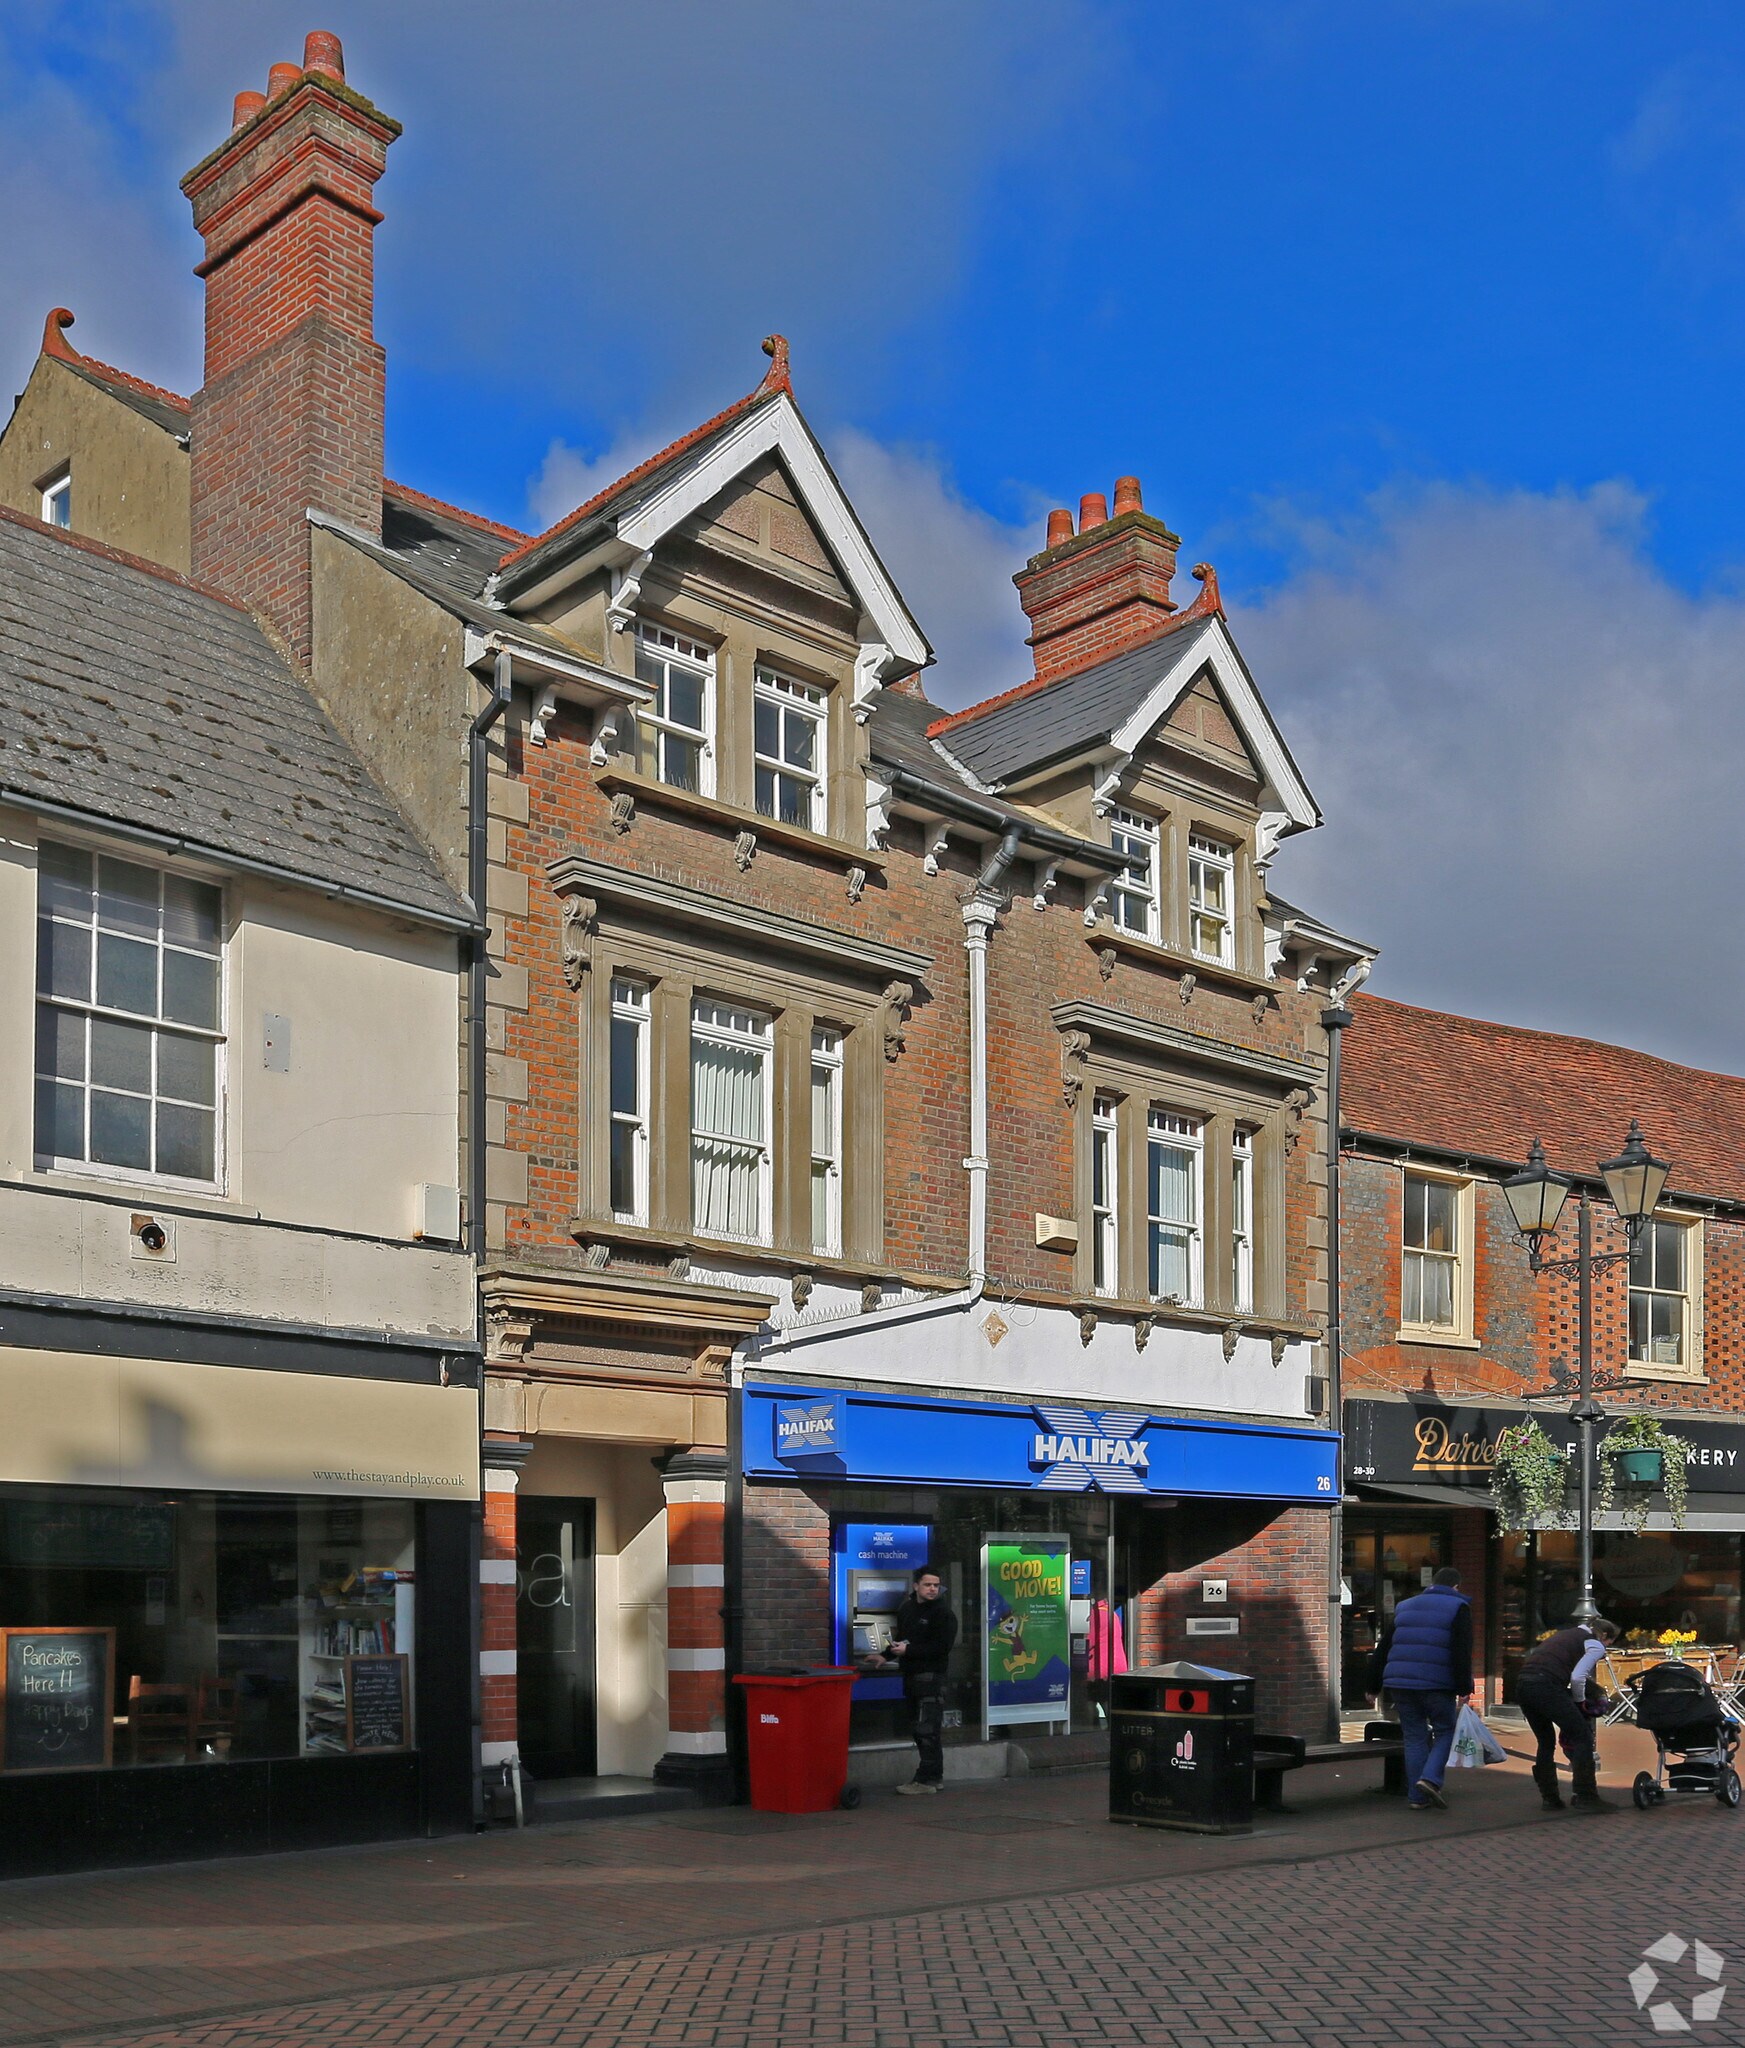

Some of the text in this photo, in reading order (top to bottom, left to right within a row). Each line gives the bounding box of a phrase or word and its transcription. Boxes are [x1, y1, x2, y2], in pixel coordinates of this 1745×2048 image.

[778, 1418, 835, 1436] HALIFAX
[1035, 1434, 1150, 1466] HALIFAX
[1414, 1417, 1508, 1464] Darvel
[1686, 1448, 1738, 1467] KERY
[312, 1469, 465, 1488] www.thestayandplay.co.uk
[1353, 1466, 1376, 1475] 28-30
[1316, 1476, 1331, 1491] 26
[858, 1550, 909, 1559] cash machine
[1000, 1559, 1043, 1581] GOOD
[1014, 1575, 1062, 1600] MOVE!
[1207, 1587, 1222, 1596] 26
[23, 1645, 82, 1666] Pancakes
[24, 1702, 61, 1728] Happy
[760, 1713, 780, 1724] Biffa
[1122, 1725, 1153, 1736] LITTER
